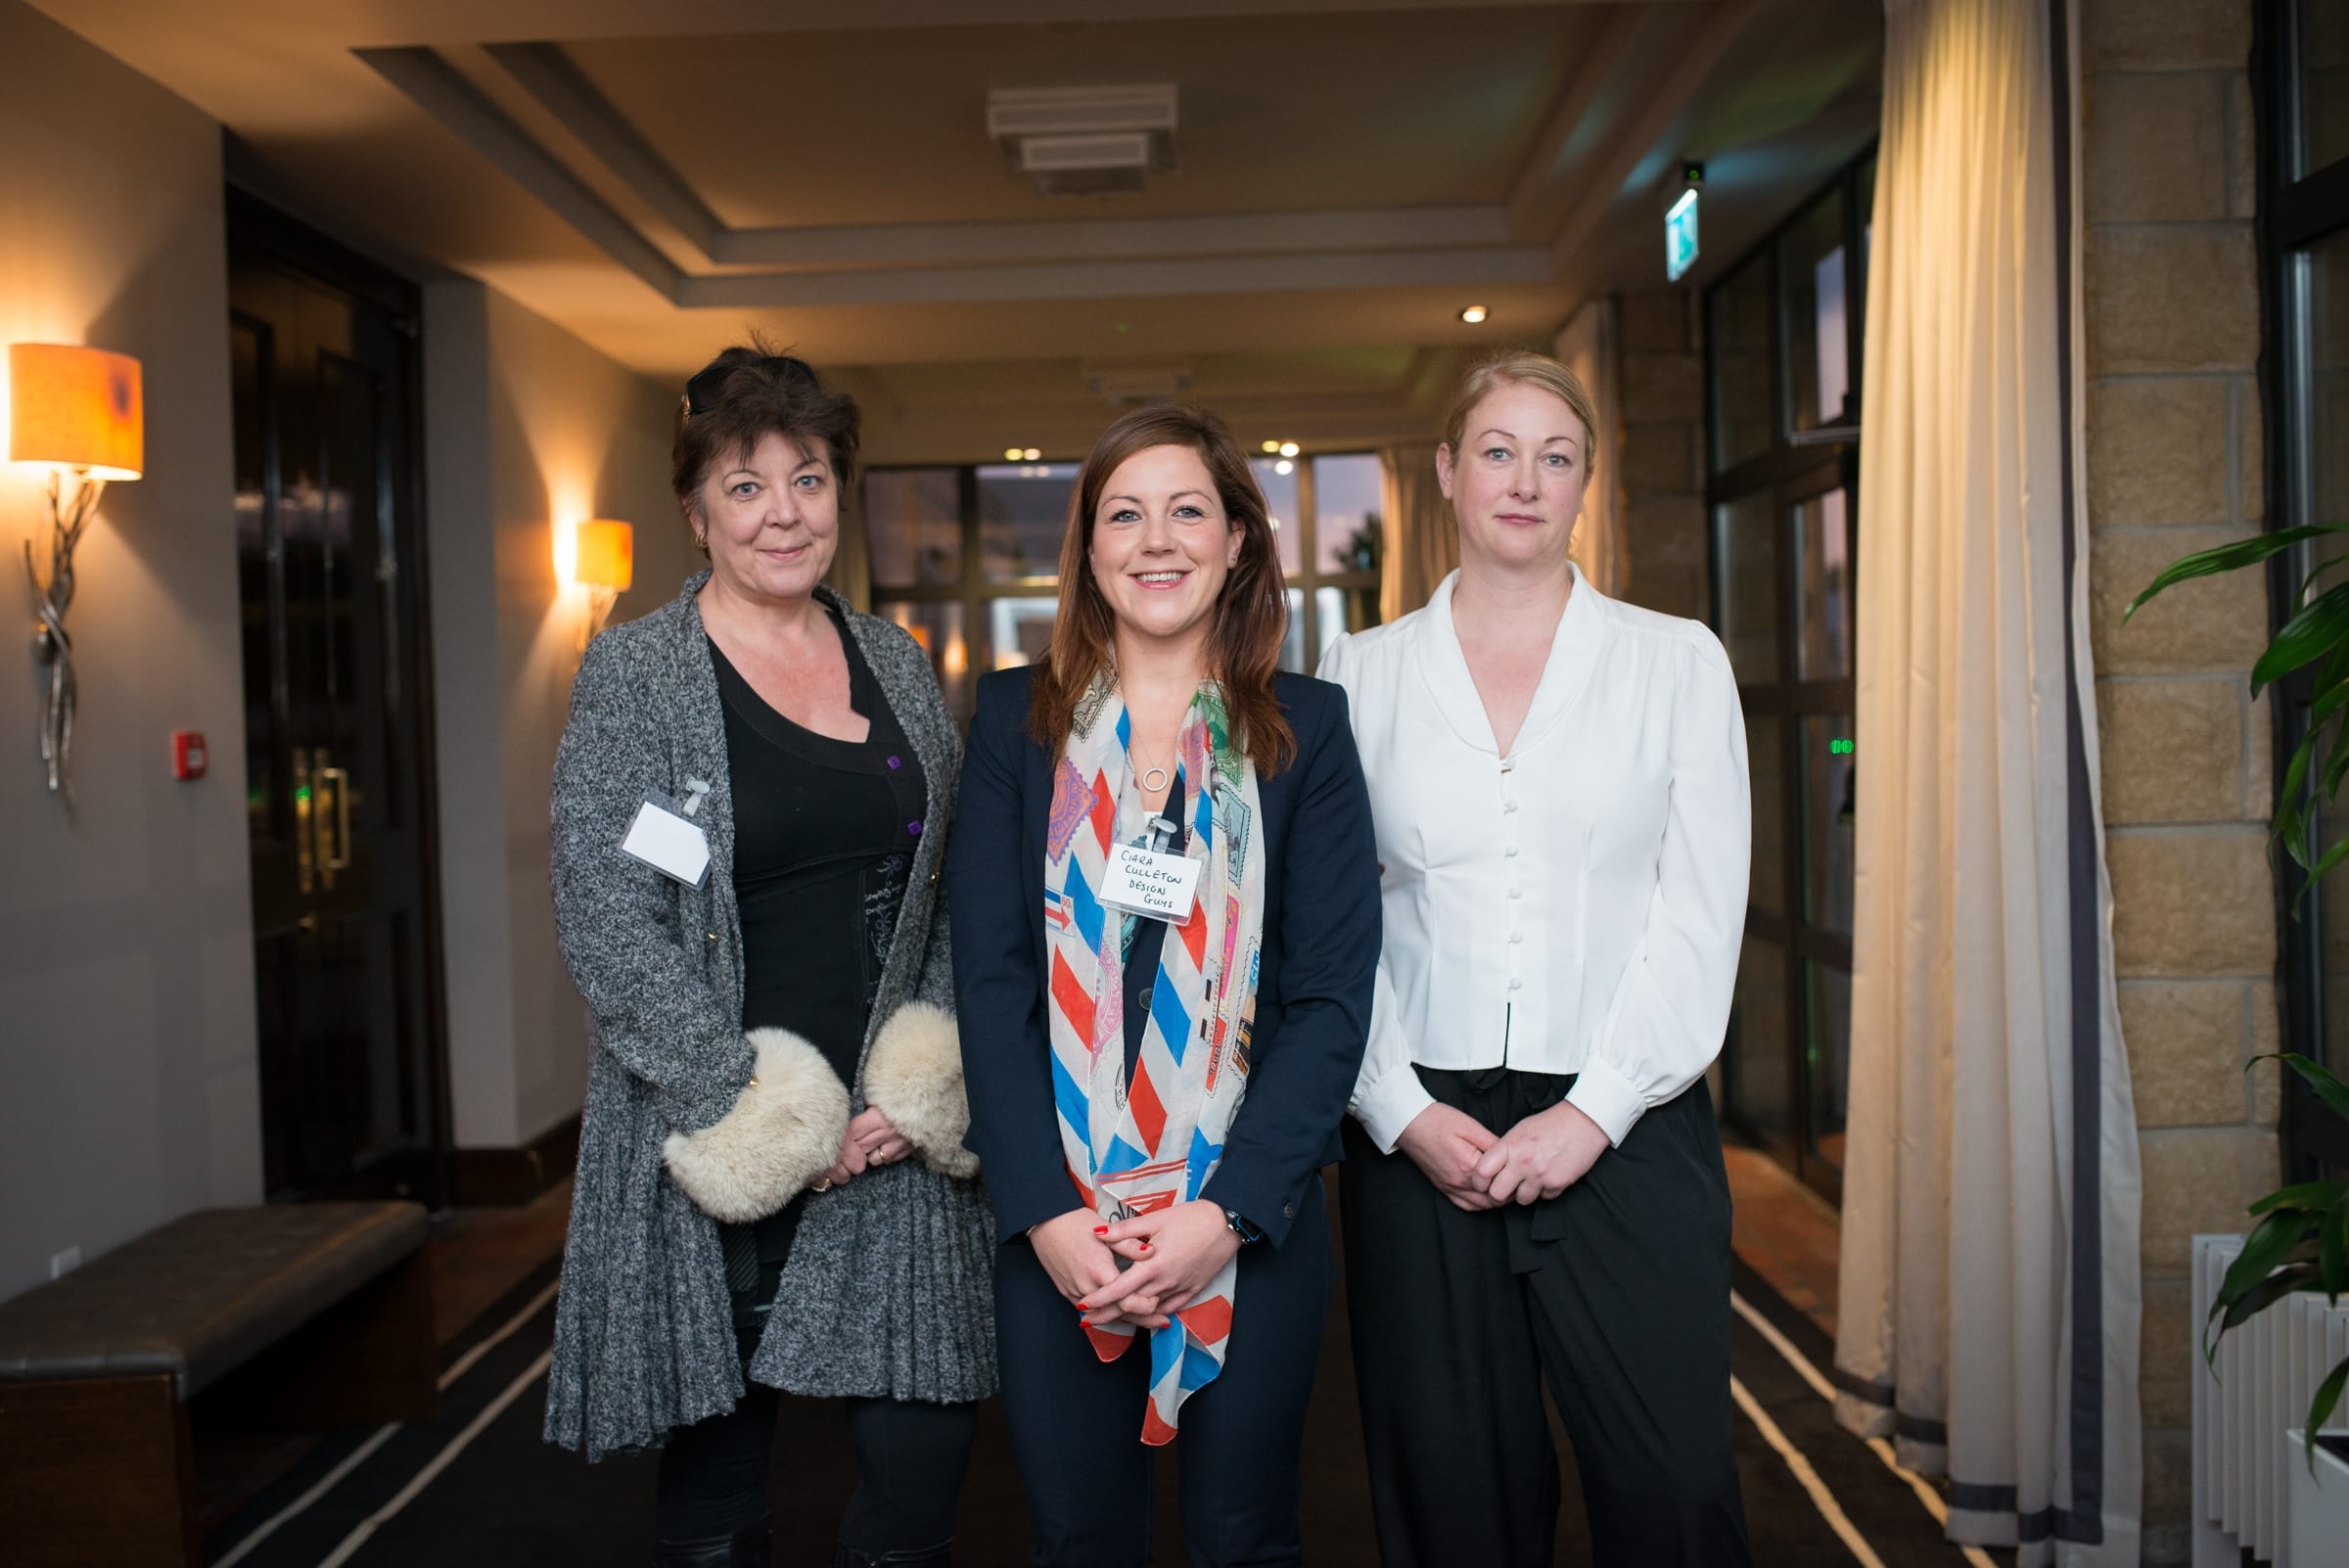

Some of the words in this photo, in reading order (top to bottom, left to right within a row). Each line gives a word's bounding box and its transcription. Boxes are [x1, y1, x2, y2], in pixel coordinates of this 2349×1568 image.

[1121, 850, 1153, 865] CIARA
[1125, 864, 1182, 884] CULLETON
[1128, 879, 1166, 896] DESIGN
